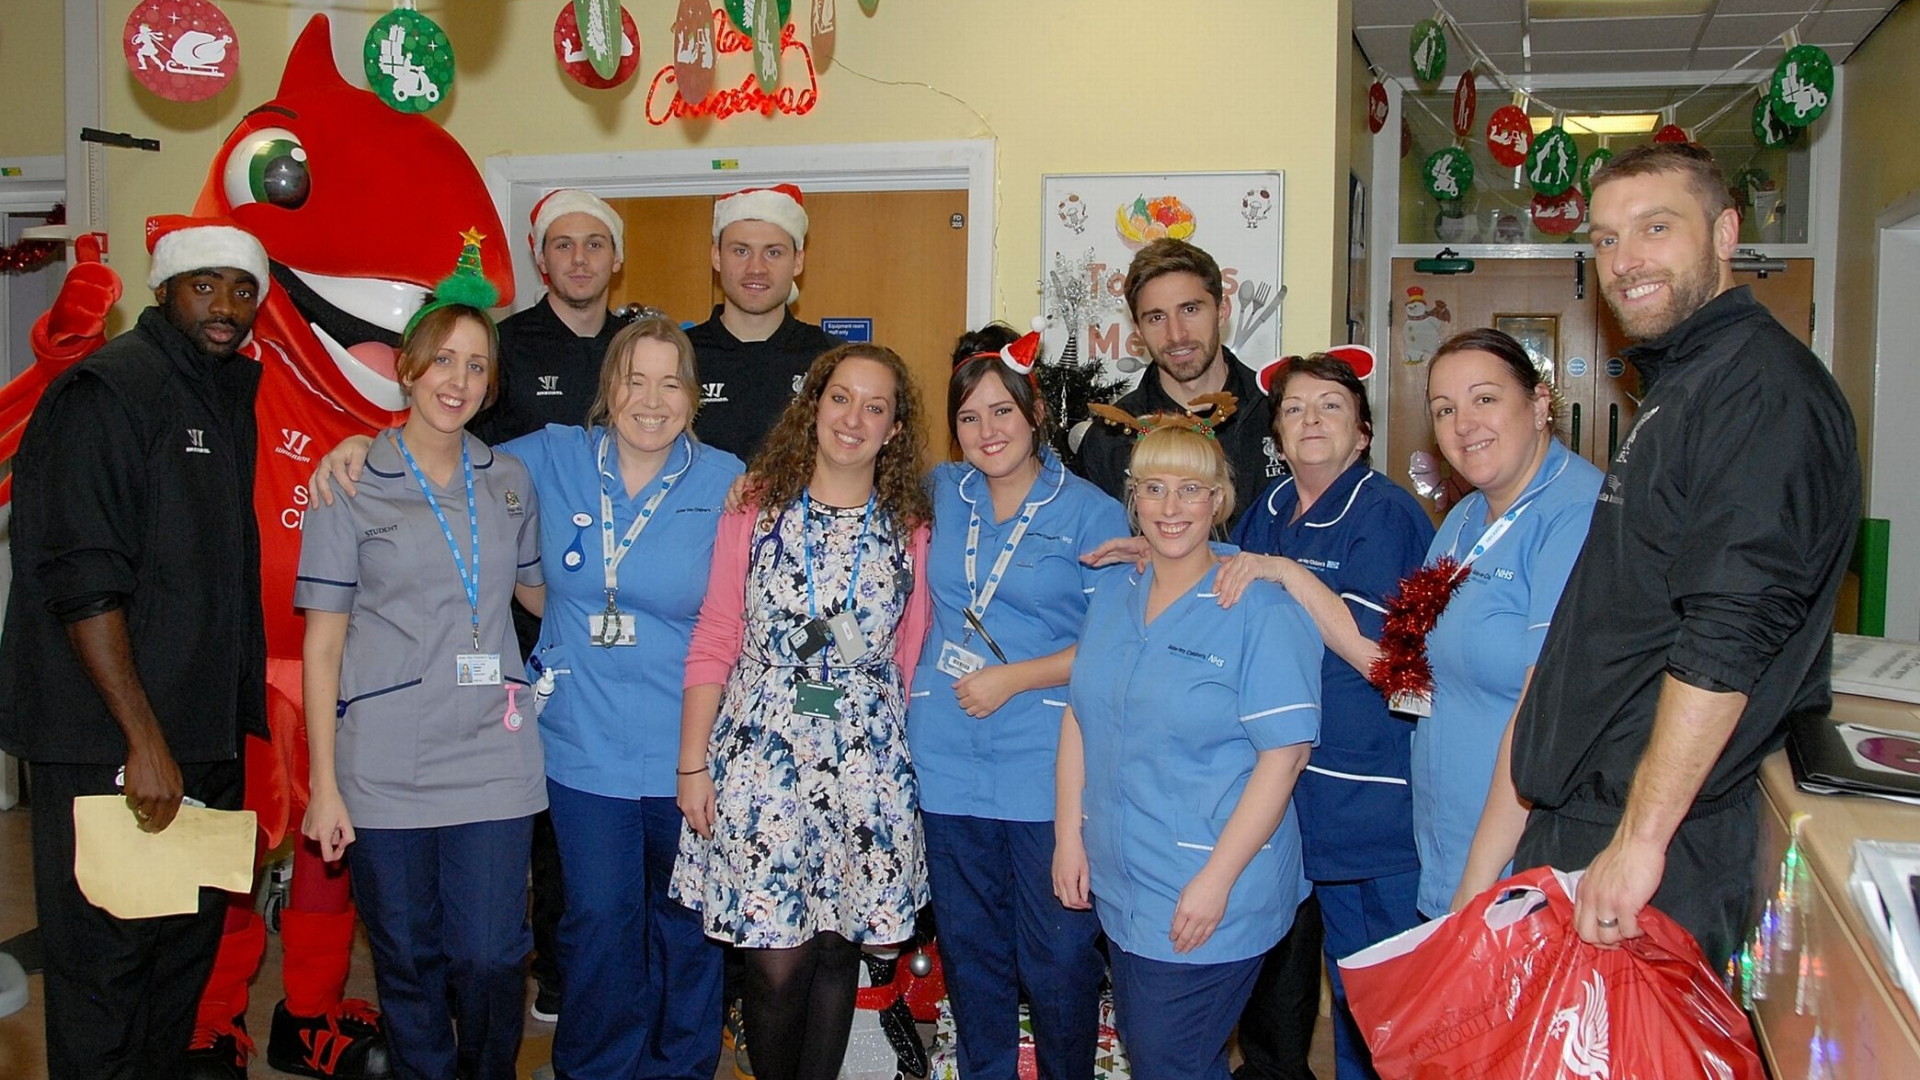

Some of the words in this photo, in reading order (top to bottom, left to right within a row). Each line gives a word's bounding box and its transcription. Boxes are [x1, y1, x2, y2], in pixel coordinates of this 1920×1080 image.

[364, 524, 399, 538] STUDENT
[1494, 567, 1515, 581] NHS
[1207, 653, 1225, 668] NHS
